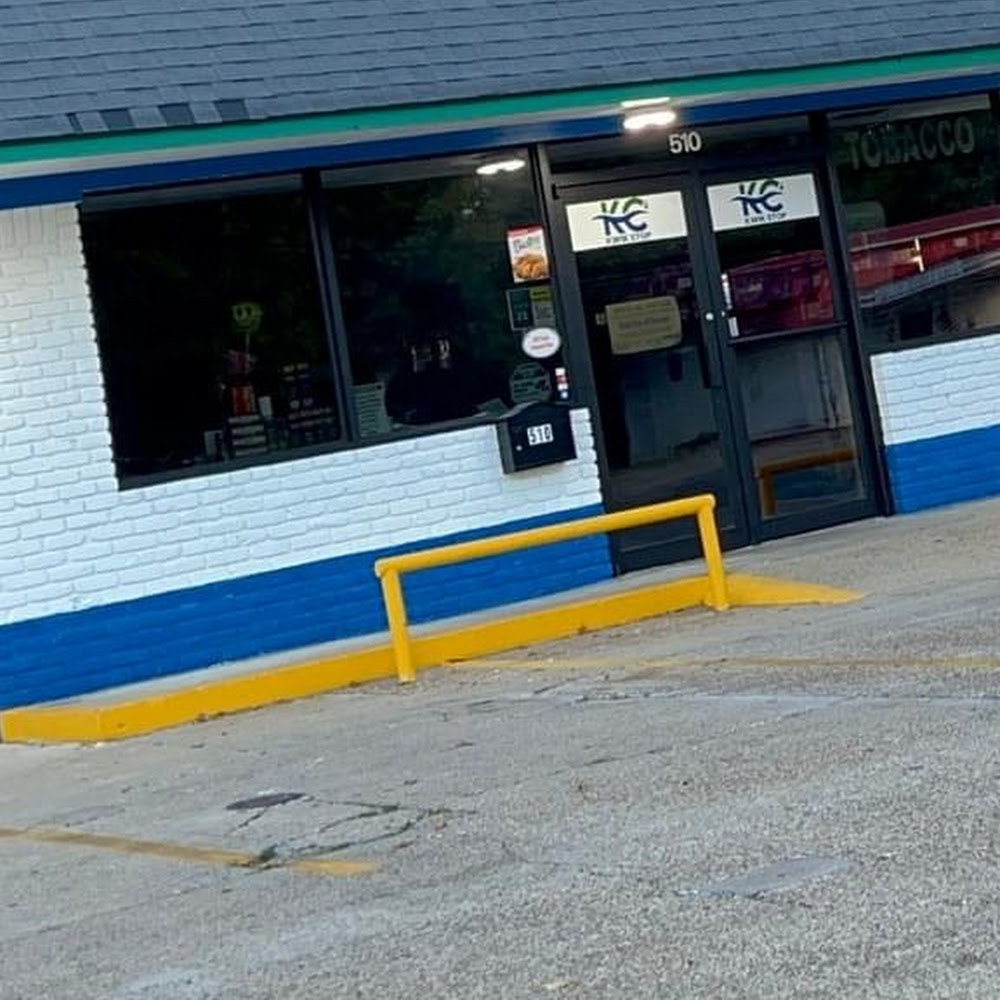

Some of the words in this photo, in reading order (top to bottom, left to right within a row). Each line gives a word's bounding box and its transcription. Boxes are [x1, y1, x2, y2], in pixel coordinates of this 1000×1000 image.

[669, 131, 702, 154] 510
[845, 116, 975, 169] TOBACCO
[529, 425, 552, 443] 510
